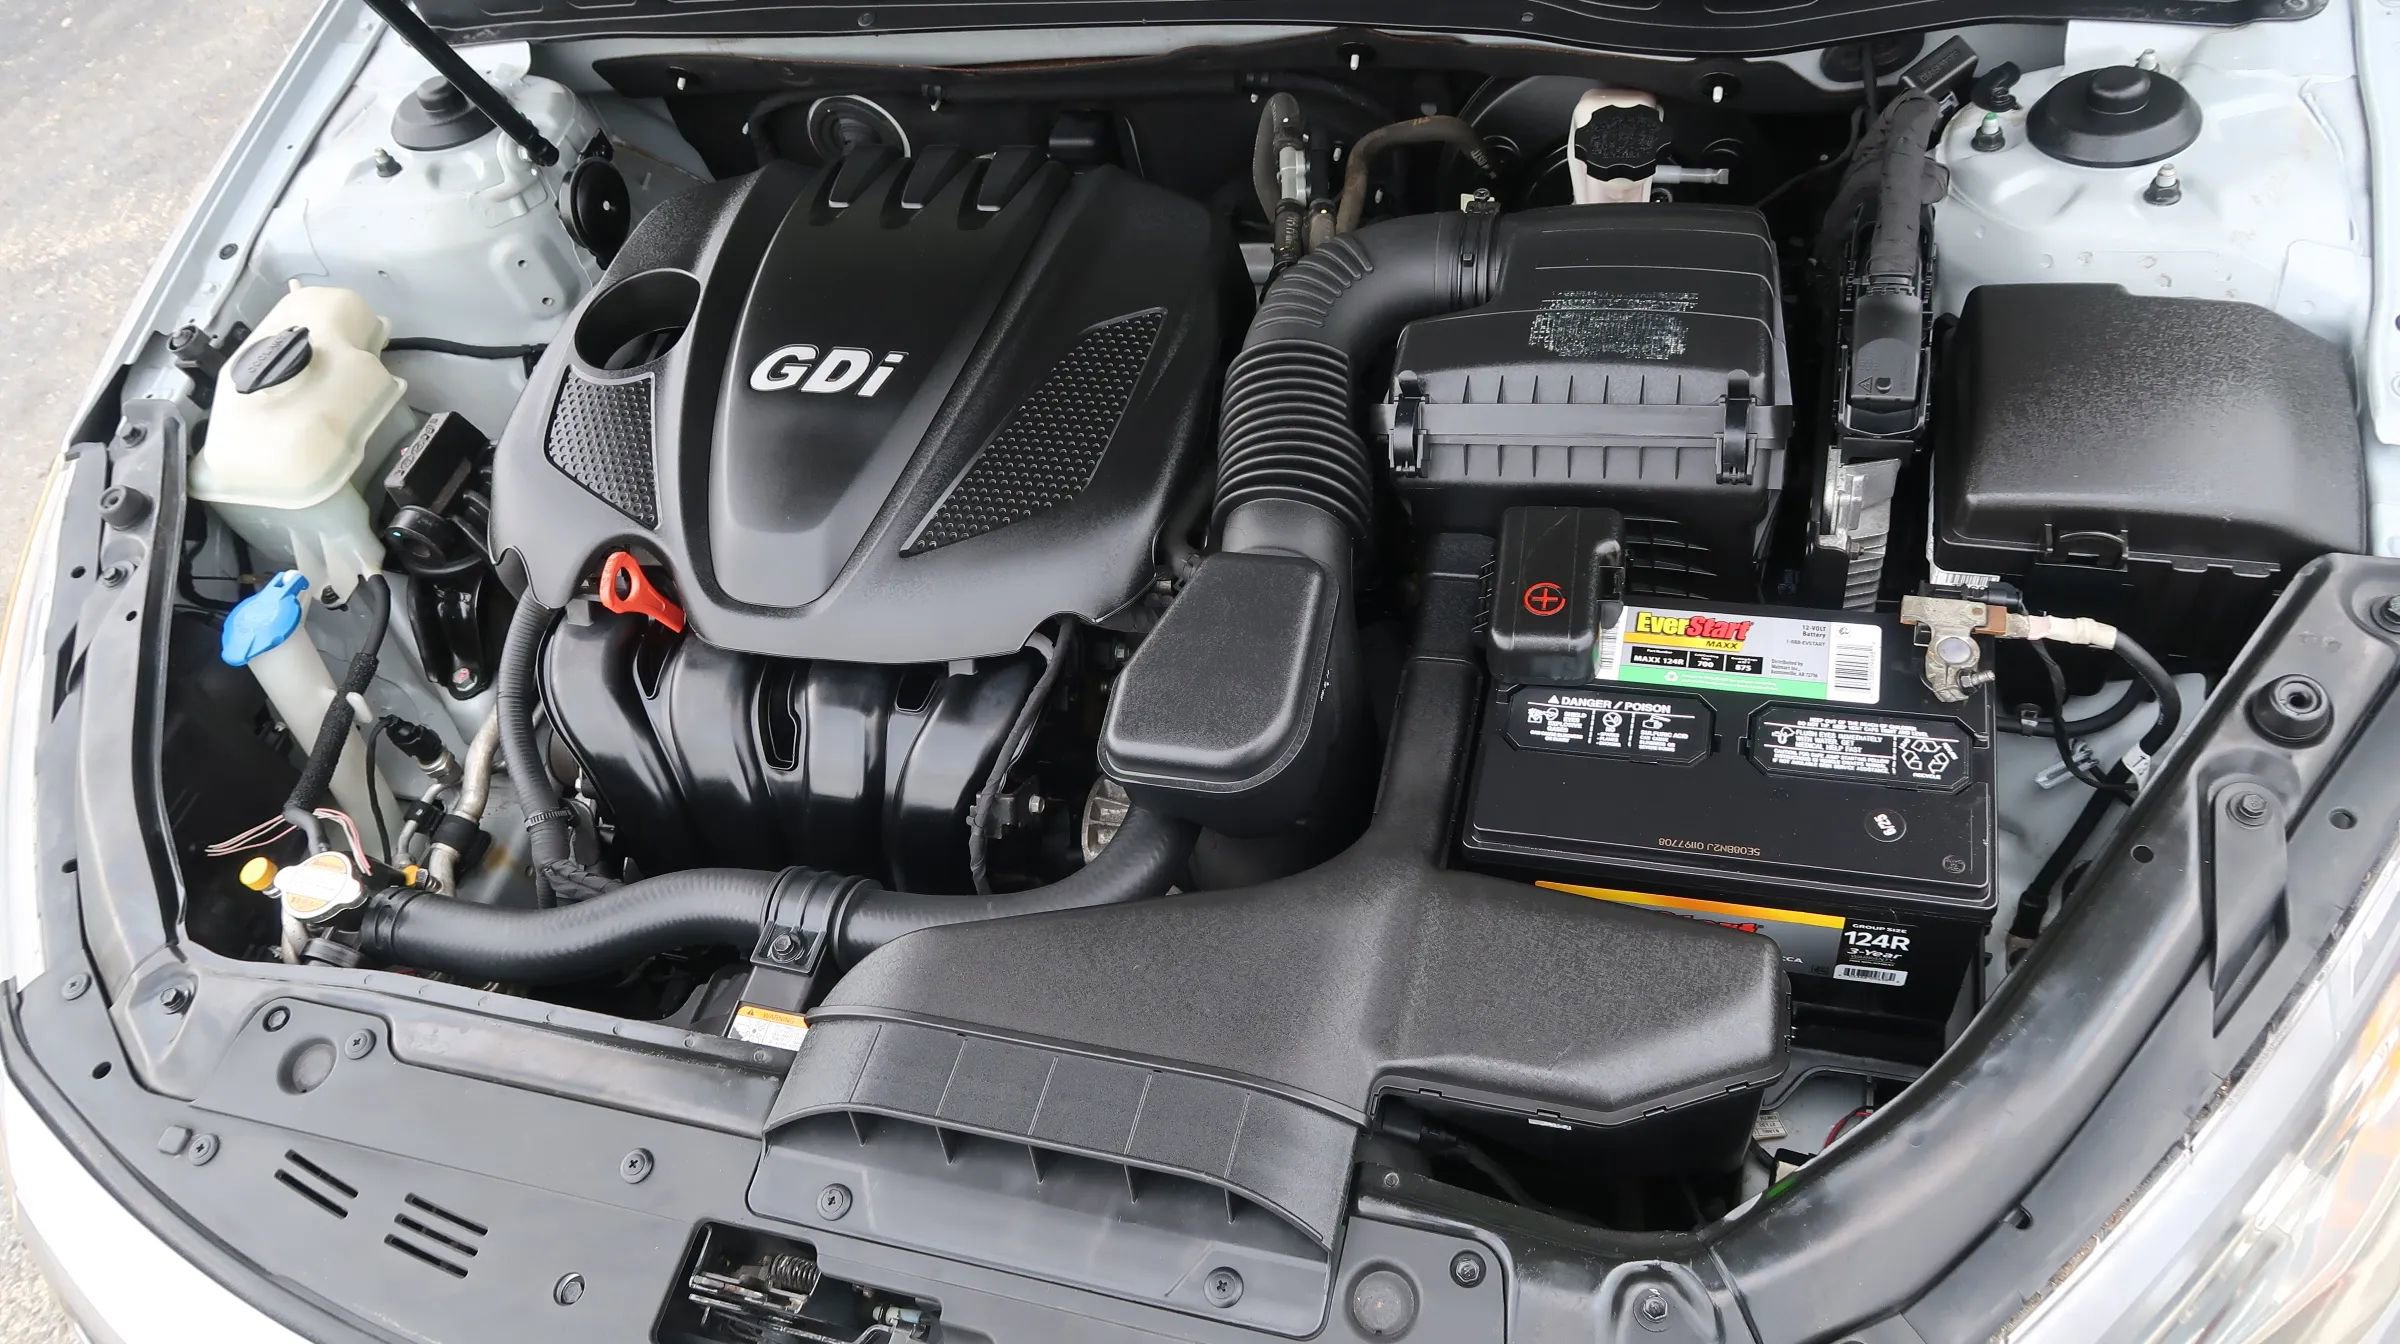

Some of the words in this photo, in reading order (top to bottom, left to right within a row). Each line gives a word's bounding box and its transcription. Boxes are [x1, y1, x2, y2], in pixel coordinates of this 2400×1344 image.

[750, 344, 908, 397] GDi
[1636, 611, 1751, 640] EverStart
[1706, 640, 1738, 649] MAXX
[1634, 655, 1660, 664] MAXX
[1663, 658, 1684, 666] 124R
[1697, 660, 1714, 668] 700
[1735, 664, 1752, 672] 875
[1561, 696, 1611, 709] DANGER
[1624, 701, 1671, 714] POISON
[1838, 733, 1883, 743] IMMEDIATELY
[1795, 742, 1824, 750] MEDICAL
[1844, 931, 1910, 951] 124R
[1847, 948, 1903, 959] 3-Year
